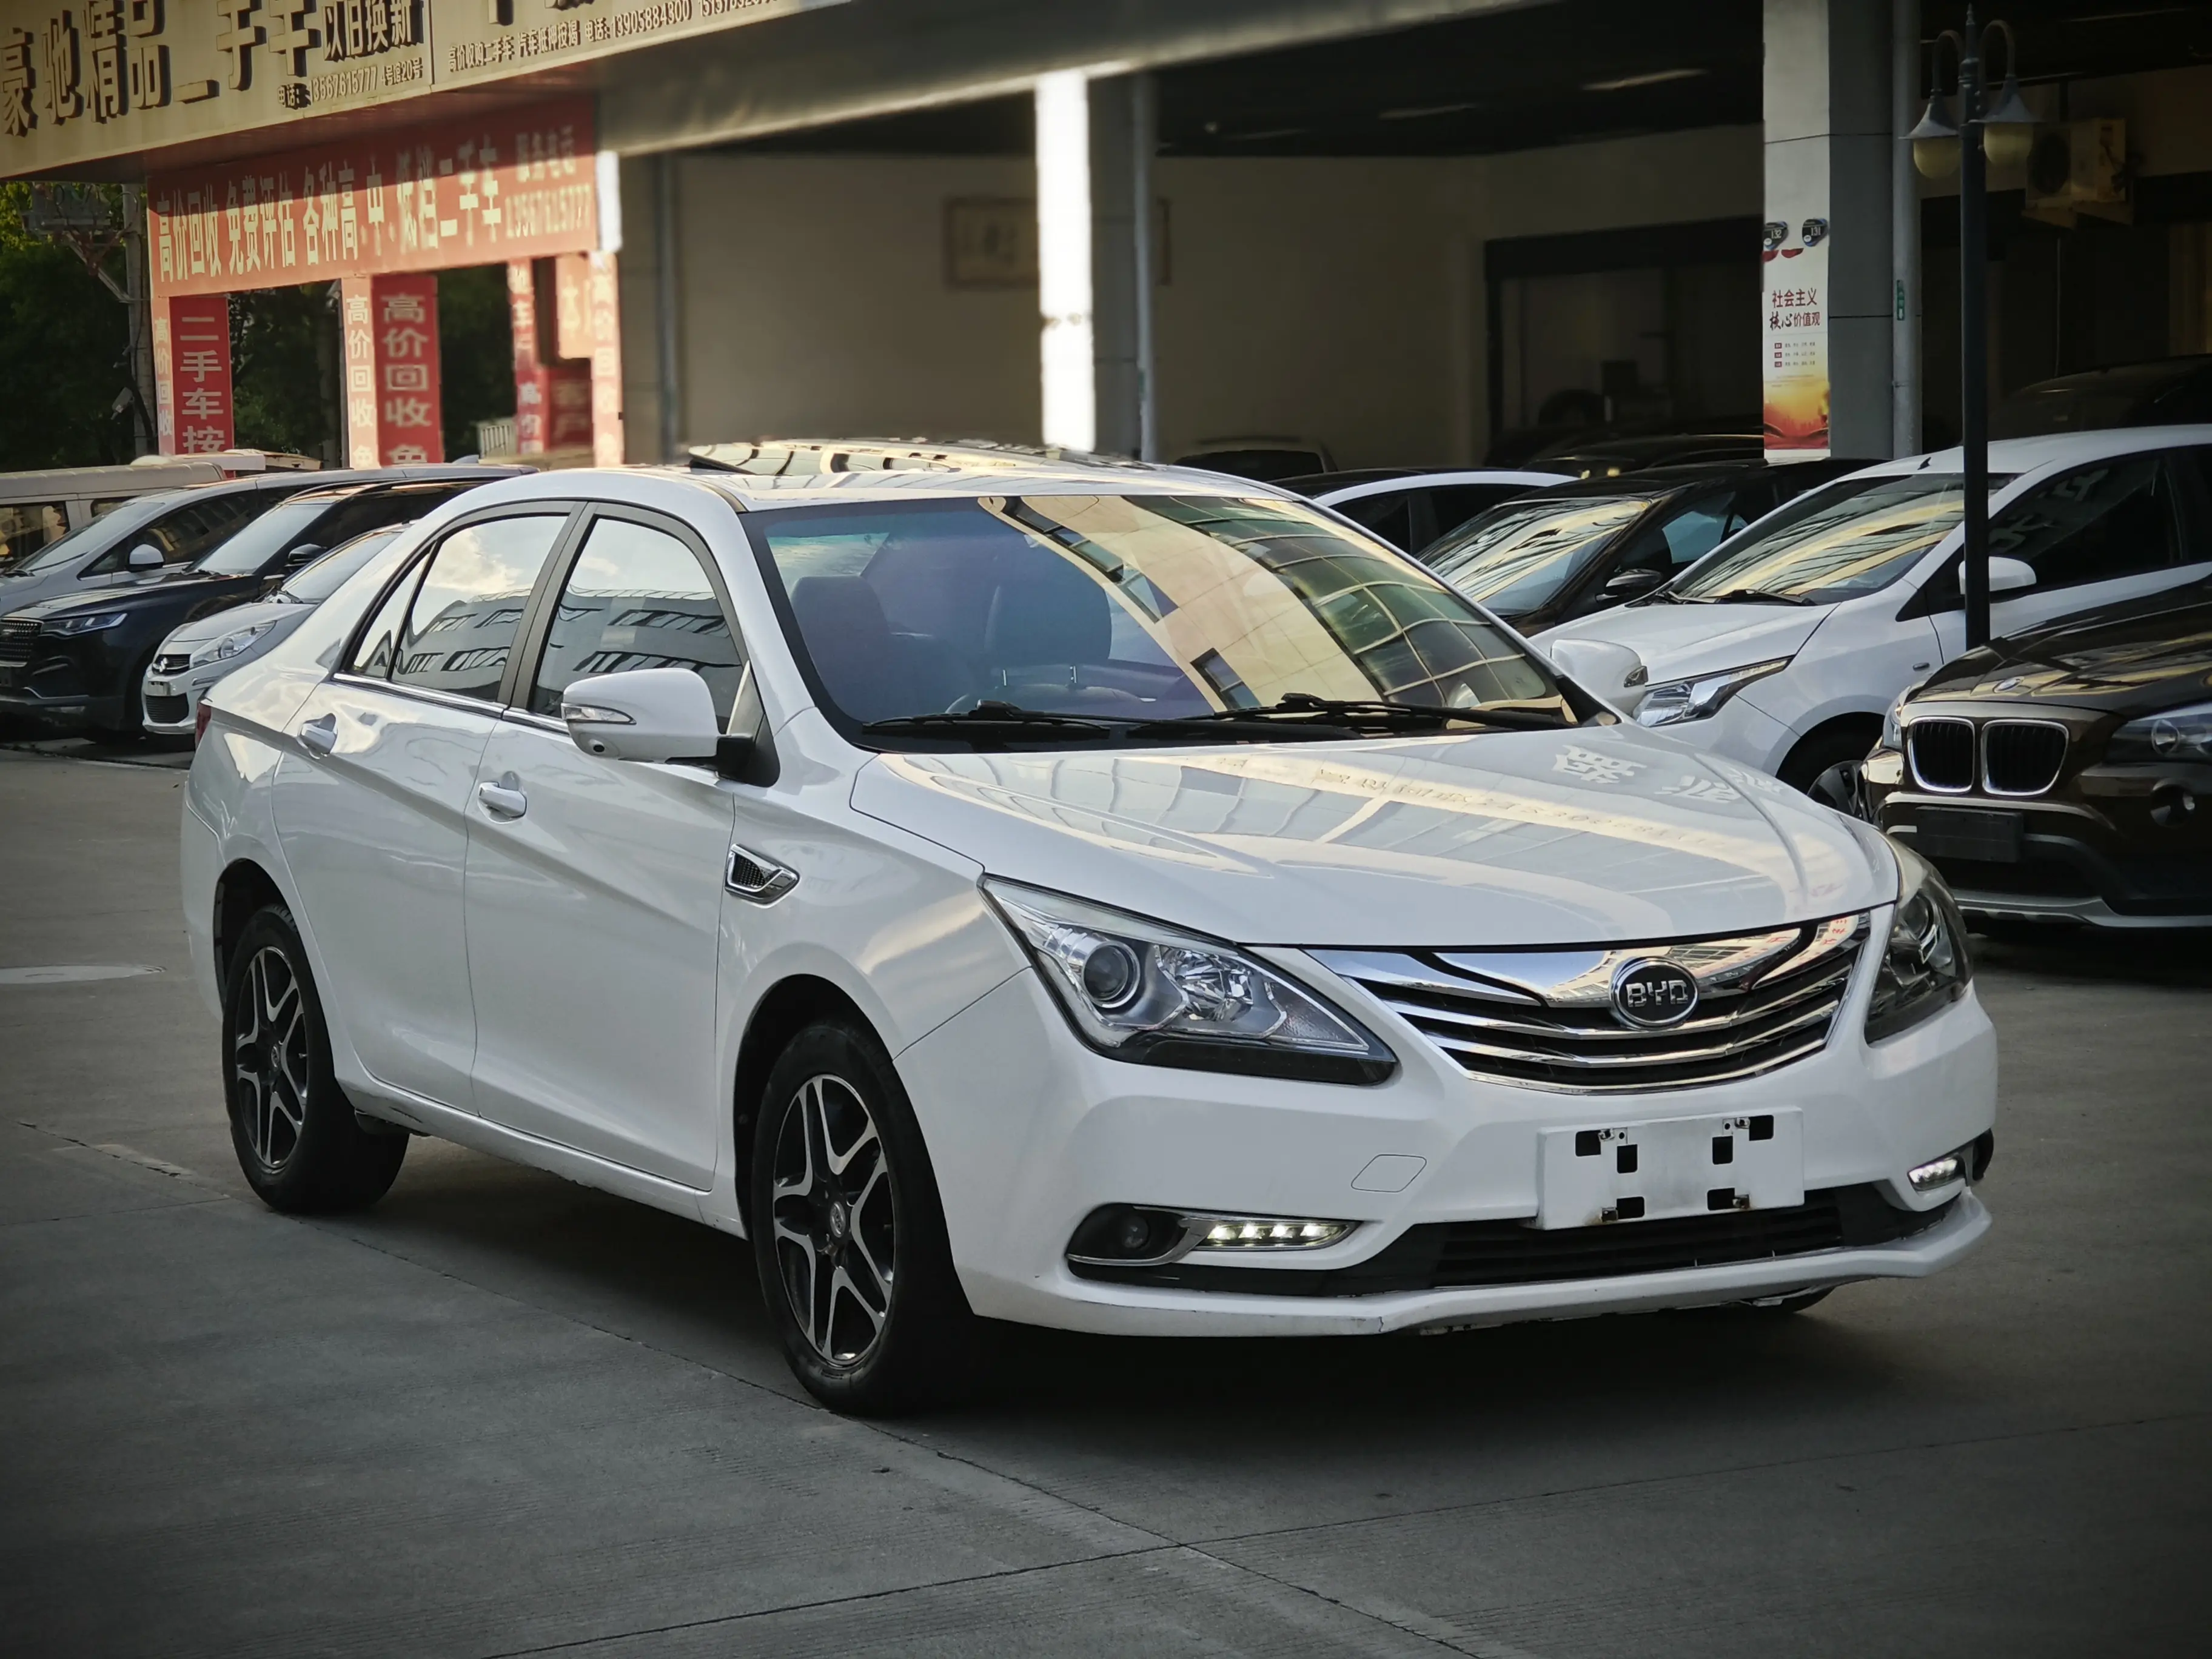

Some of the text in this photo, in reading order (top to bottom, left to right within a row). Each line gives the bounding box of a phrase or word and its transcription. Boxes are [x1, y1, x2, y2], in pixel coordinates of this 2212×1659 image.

[322, 0, 417, 60] 以旧换新
[447, 35, 515, 72] 高价收购二手车
[157, 183, 221, 283] 高价回收
[226, 171, 296, 275] 免费评估
[1772, 287, 1817, 308] 社会主义
[1769, 311, 1820, 331] 核心价值观
[1626, 979, 1689, 1007] BYD
